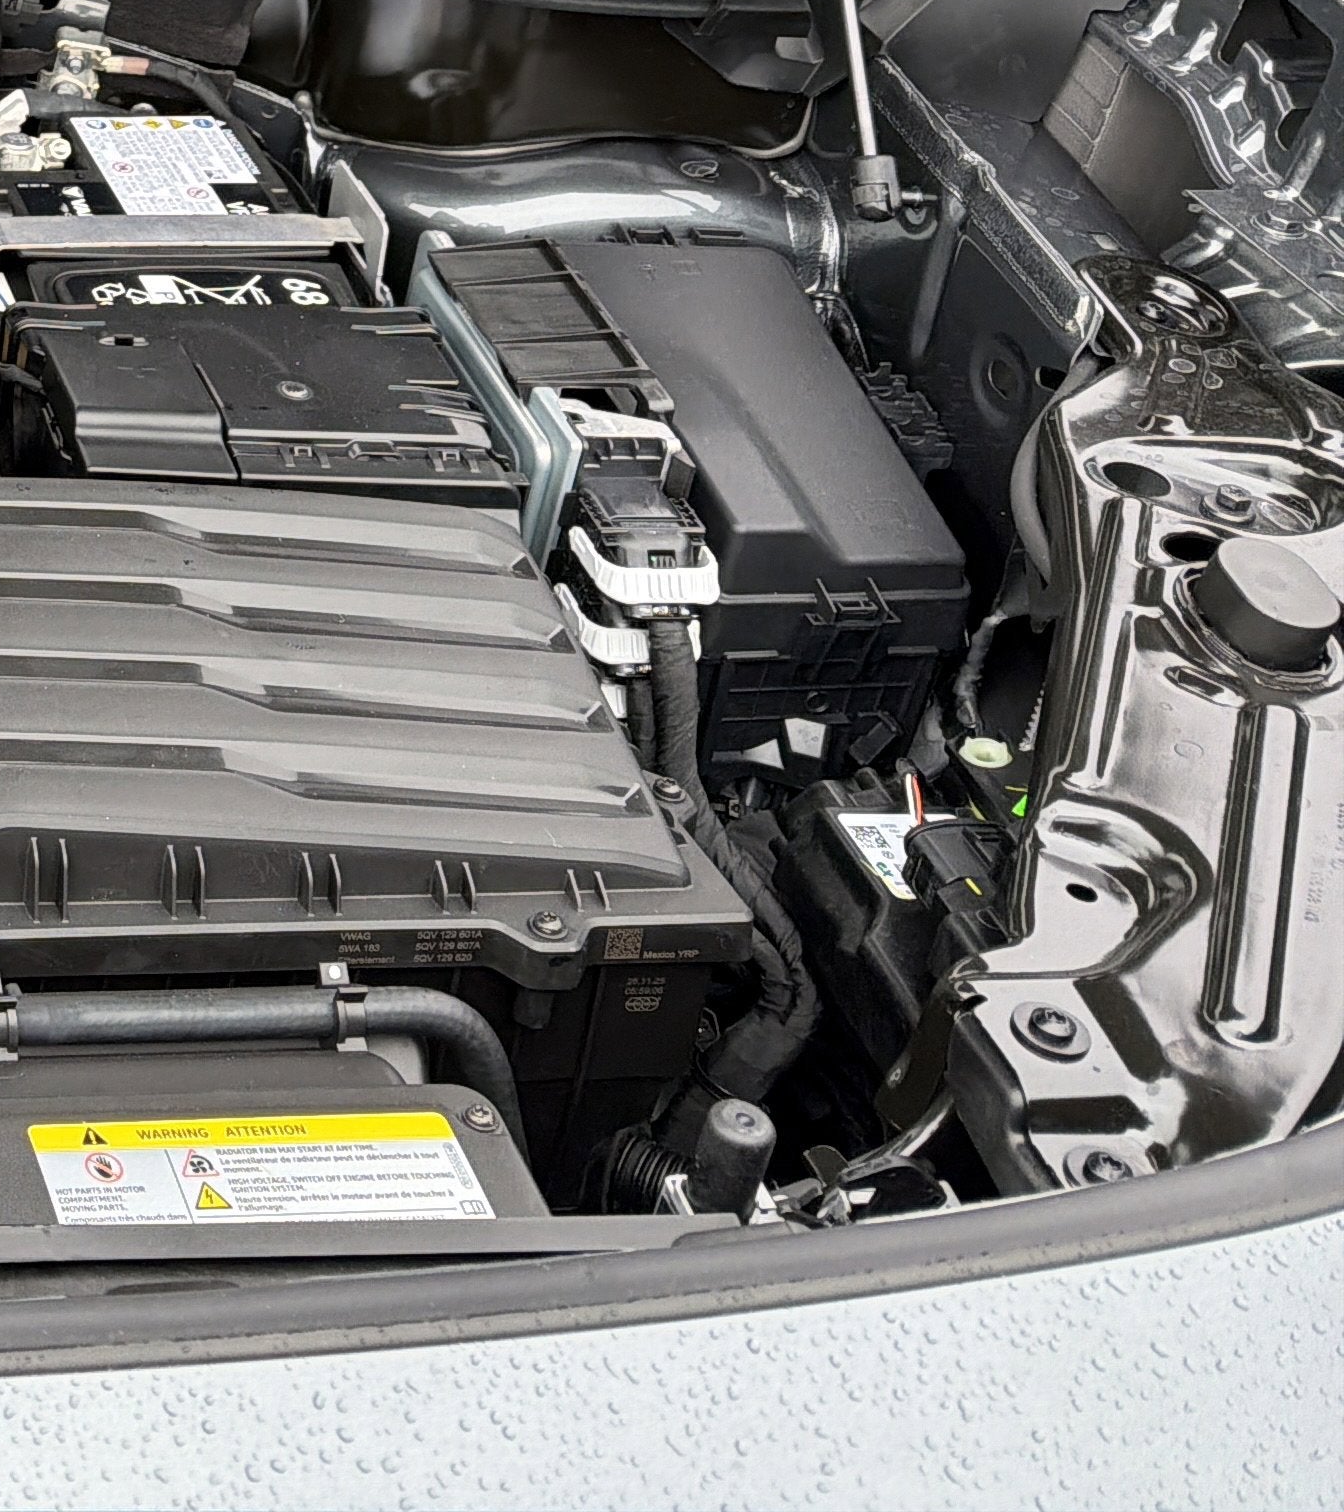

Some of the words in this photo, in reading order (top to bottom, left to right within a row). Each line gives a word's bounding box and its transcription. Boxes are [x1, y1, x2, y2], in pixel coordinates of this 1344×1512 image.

[340, 932, 371, 941] VWAG
[441, 930, 457, 939] 129
[439, 942, 455, 950] 129
[642, 950, 676, 959] Mexico
[136, 1127, 209, 1140] WARNING
[226, 1124, 307, 1138] ATTENTION
[216, 1148, 258, 1156] RADIATOR
[259, 1147, 277, 1155] FAN
[278, 1146, 296, 1154] MAY
[297, 1145, 324, 1154] START
[228, 1178, 250, 1186] HIGH
[292, 1175, 325, 1184] SWITCH
[343, 1174, 375, 1182] ENGINE
[411, 1171, 455, 1179] TOUCHING
[55, 1188, 73, 1196] HOT
[75, 1187, 102, 1195] PARTS
[114, 1185, 146, 1194] MOTOR
[231, 1185, 270, 1193] IGNITION
[61, 1205, 97, 1213] MOVING
